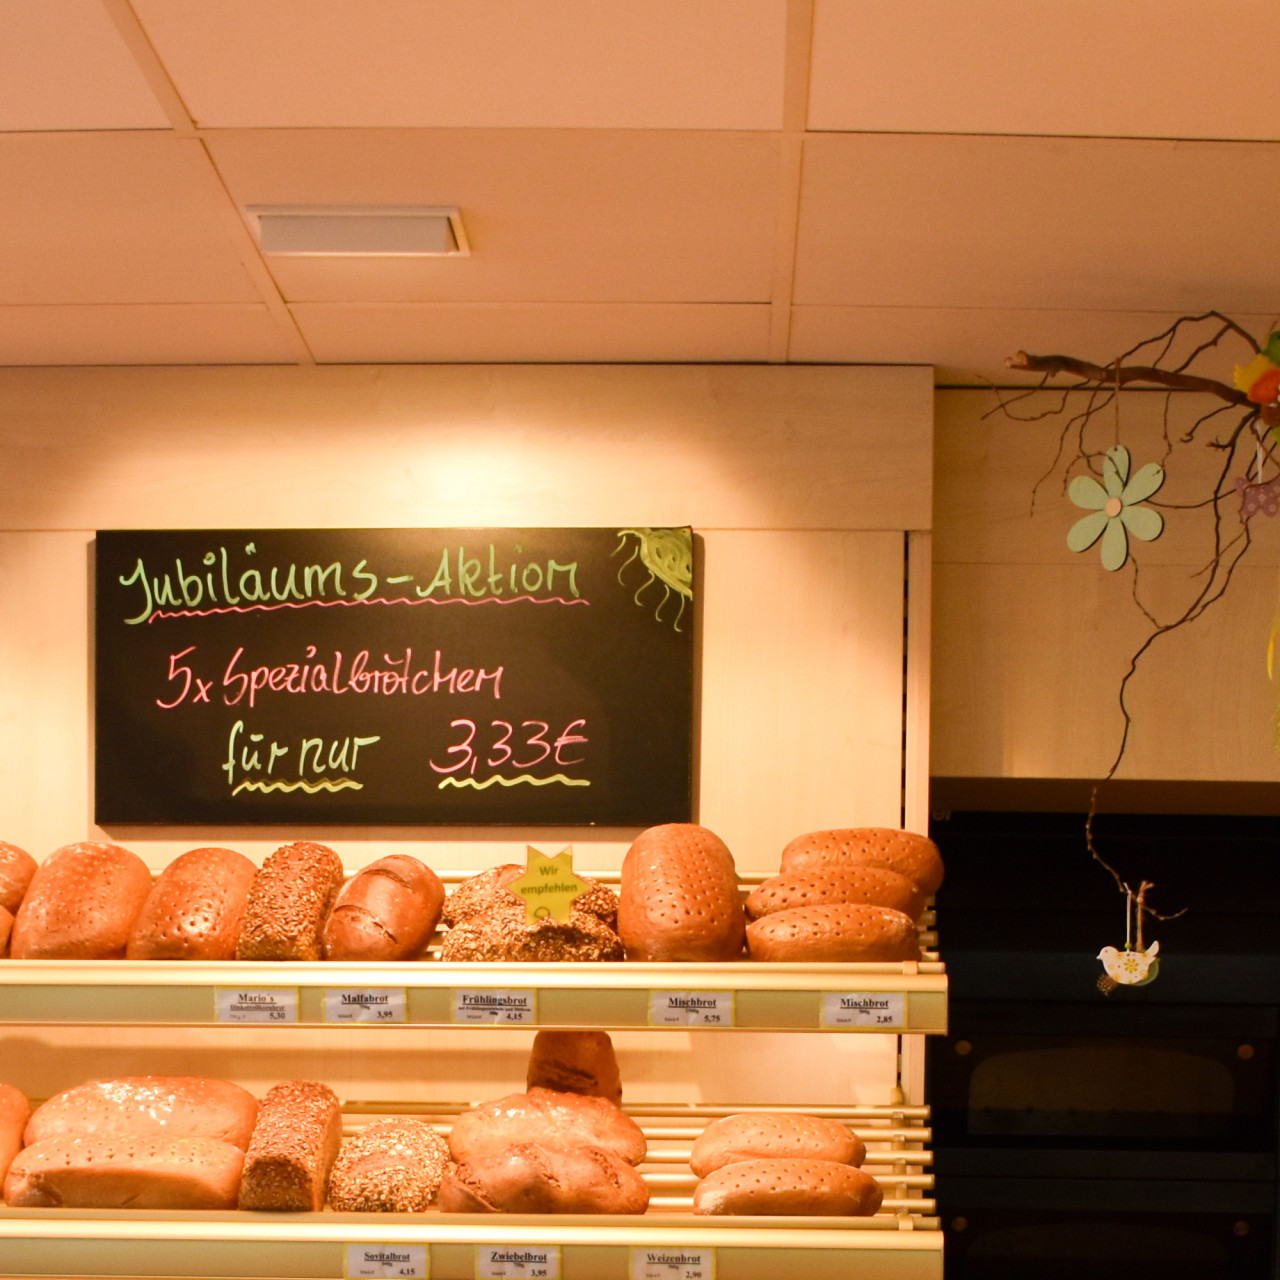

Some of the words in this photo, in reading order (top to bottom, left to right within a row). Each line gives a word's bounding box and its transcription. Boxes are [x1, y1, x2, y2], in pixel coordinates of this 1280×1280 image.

[119, 542, 580, 625] Jubiläums-Aktion
[222, 645, 504, 708] Spezialbrötchen
[222, 720, 288, 786] für
[298, 735, 380, 776] nur
[539, 866, 559, 876] Wir
[520, 883, 578, 895] empfehlen
[342, 994, 389, 1003] Malfabrot
[462, 994, 528, 1006] Frühlingsbrot
[668, 997, 717, 1007] Mischbrot
[840, 998, 889, 1007] Mischbrot
[704, 1015, 721, 1023] 5,75
[364, 1252, 410, 1261] Sovitalbrot
[491, 1251, 548, 1261] Zwiebelbrot
[647, 1254, 701, 1263] Weizenbrot
[685, 1271, 702, 1279] 2,90
